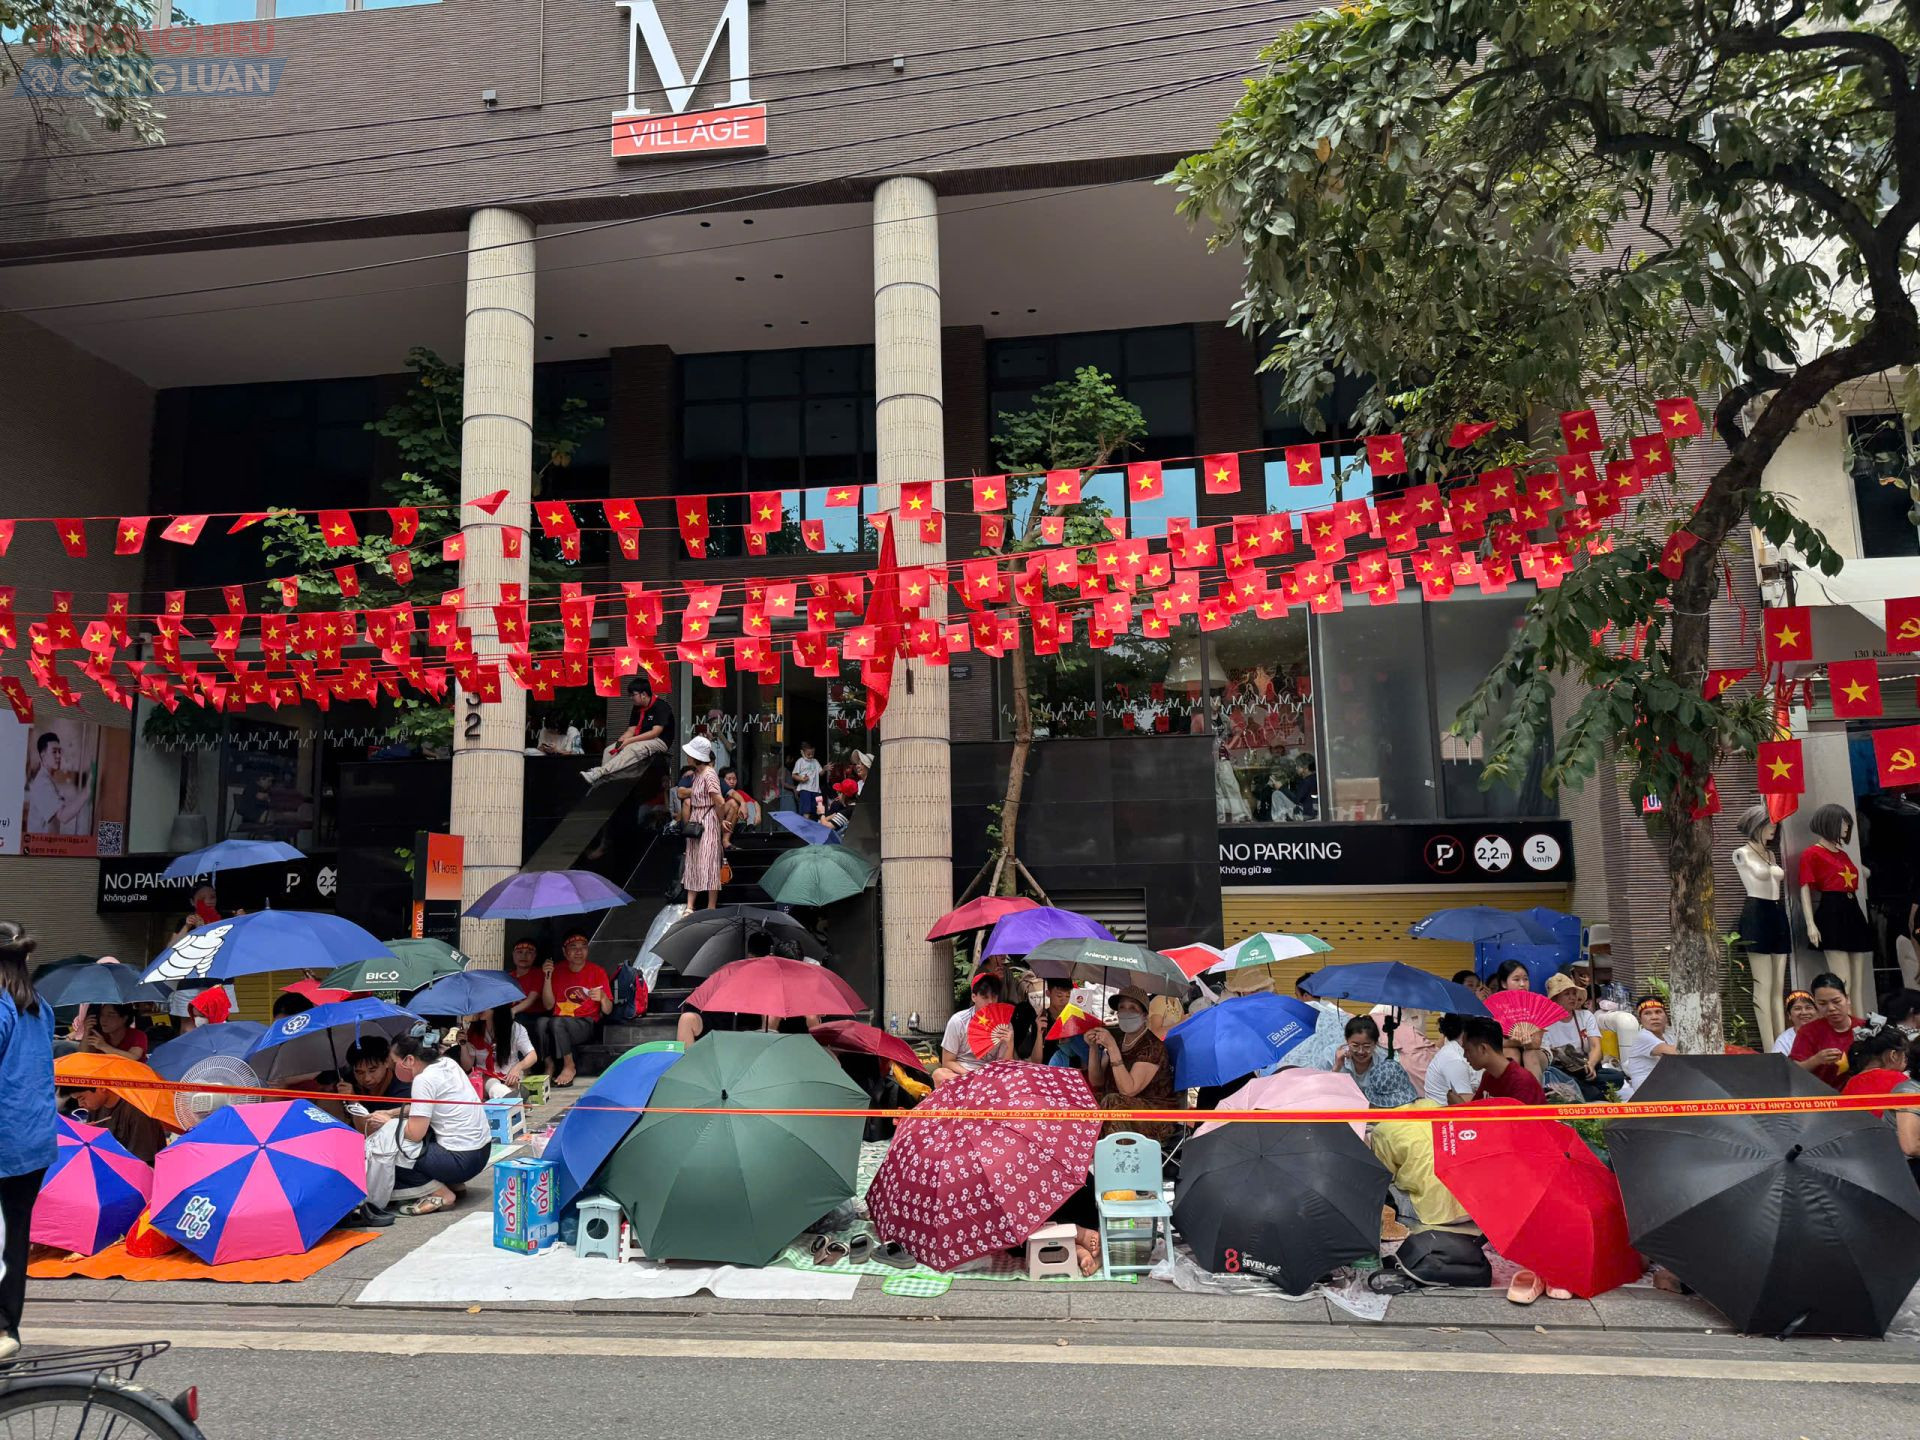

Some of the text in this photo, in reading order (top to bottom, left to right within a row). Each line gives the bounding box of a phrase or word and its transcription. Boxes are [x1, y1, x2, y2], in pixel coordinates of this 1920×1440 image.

[614, 0, 766, 116] M
[629, 116, 750, 148] VILLAGE
[1219, 842, 1342, 860] NO PARKING
[1536, 841, 1546, 853] 5
[1532, 855, 1553, 863] km/h
[442, 864, 458, 874] HOTEL
[1219, 866, 1247, 875] Không
[105, 873, 132, 889] NO
[104, 894, 126, 902] Không
[366, 970, 400, 980] BICO
[1557, 1106, 1586, 1115] CROSS
[1588, 1106, 1605, 1115] NOT
[1644, 1104, 1674, 1113] POLICE
[1242, 1259, 1266, 1269] SEVEN
